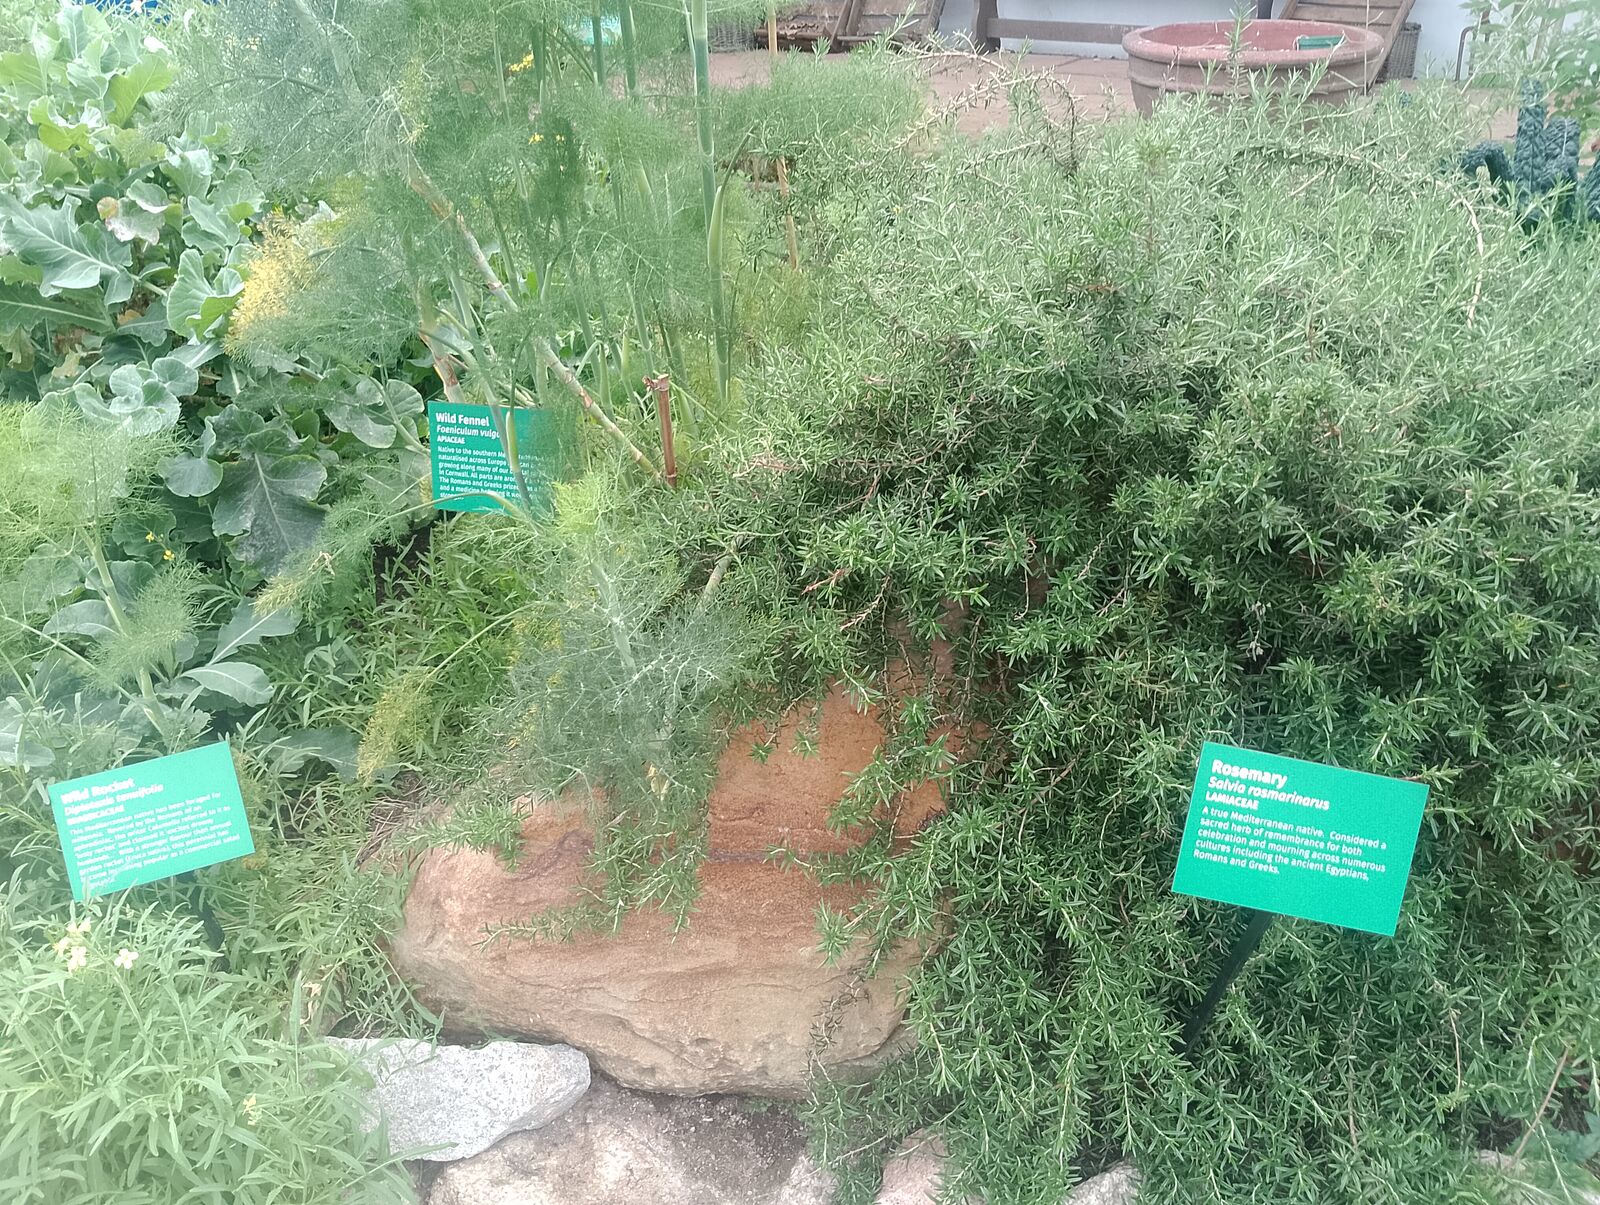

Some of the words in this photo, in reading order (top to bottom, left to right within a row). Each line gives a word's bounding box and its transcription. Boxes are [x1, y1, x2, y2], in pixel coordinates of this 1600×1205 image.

[436, 412, 456, 423] Wild
[458, 415, 489, 426] Fennel
[437, 425, 478, 435] Foeniculum
[437, 436, 465, 444] APIACEAE
[439, 462, 460, 470] growing
[488, 458, 506, 466] Europe
[1212, 760, 1287, 789] Rosemary
[61, 788, 89, 804] Wild
[1206, 791, 1259, 810] LAMIACEAE
[1208, 776, 1246, 793] Salvia
[1248, 786, 1329, 810] rosmarinarus
[1200, 818, 1229, 829] sacred
[1231, 823, 1251, 834] herb
[1254, 828, 1264, 836] of
[1265, 831, 1324, 849] remembrance
[1327, 841, 1340, 851] for
[1342, 844, 1362, 855] both
[1202, 806, 1209, 814] A
[1211, 808, 1228, 818] true
[1230, 811, 1293, 831] Mediterranean
[1296, 826, 1324, 837] native.
[1330, 831, 1379, 848] Considered
[1194, 849, 1228, 864] Romans
[1230, 858, 1246, 867] and
[1249, 860, 1279, 874] Greeks.
[1196, 840, 1230, 853] cultures
[1233, 845, 1273, 863] including
[1275, 854, 1289, 864] the
[1291, 859, 1323, 871] ancient
[1198, 829, 1247, 844] celebration
[1249, 839, 1266, 848] and
[1268, 843, 1310, 858] mourning
[1311, 852, 1340, 863] across
[1342, 858, 1385, 872] numerous
